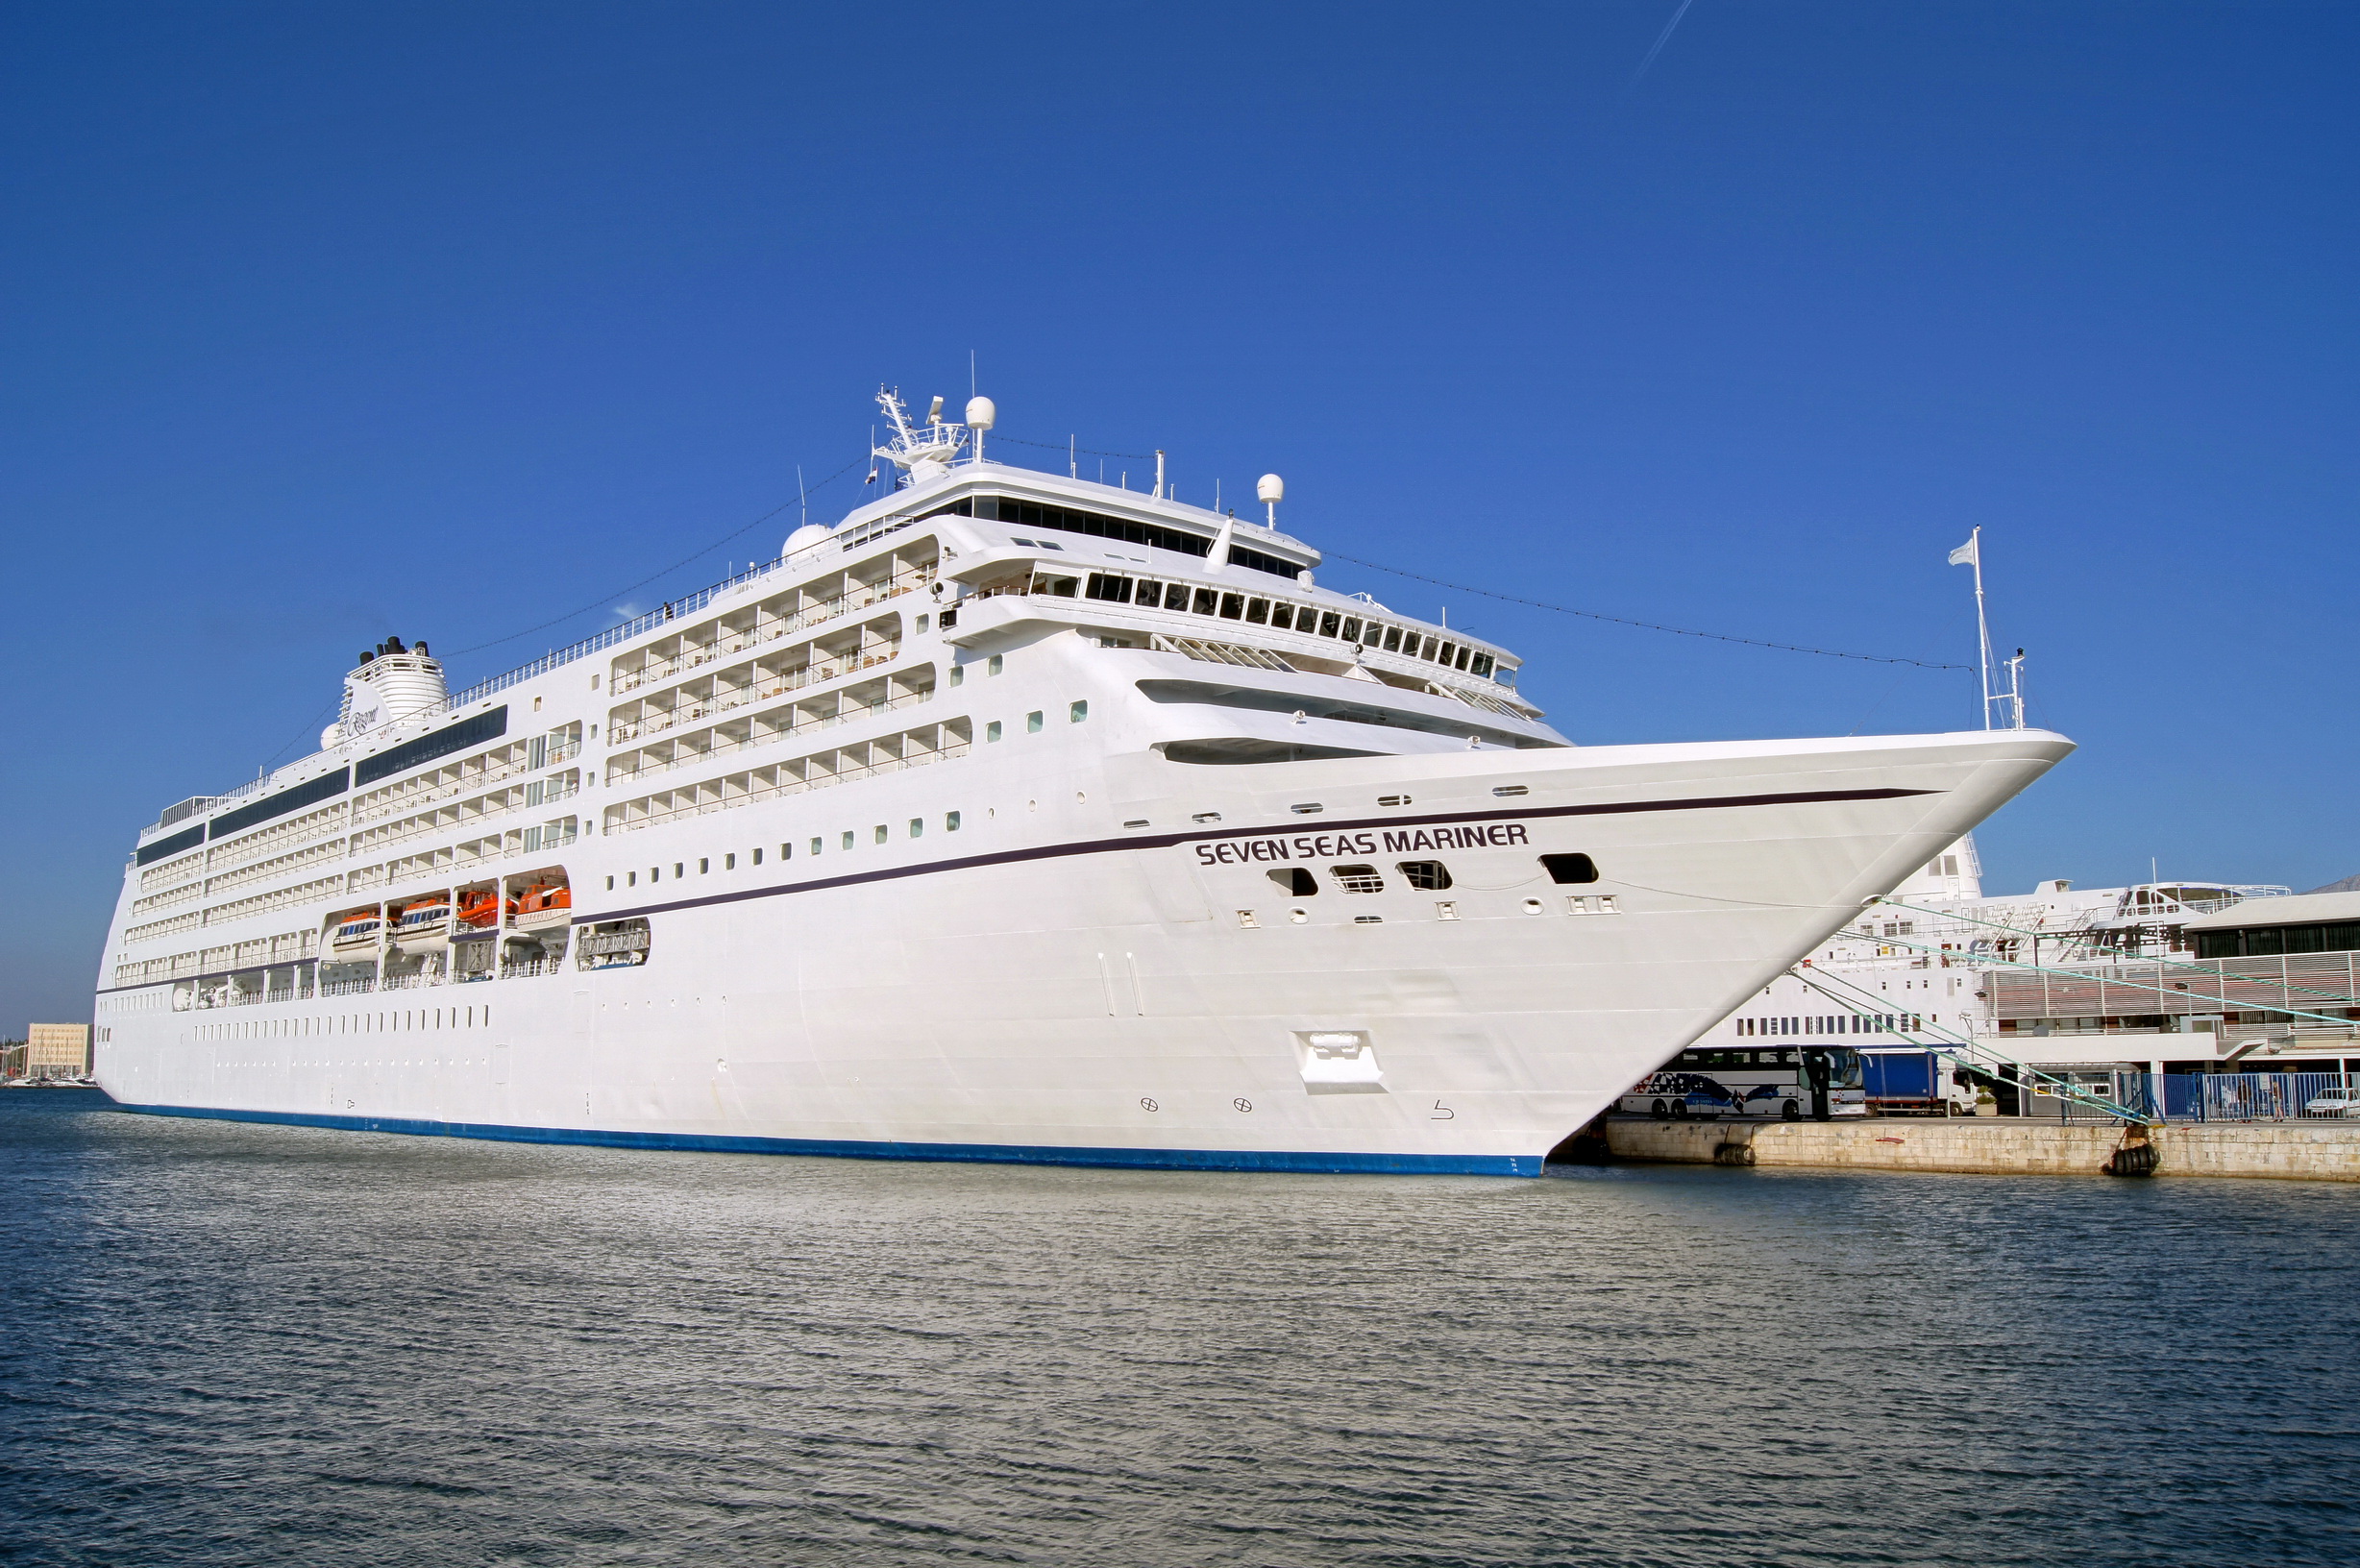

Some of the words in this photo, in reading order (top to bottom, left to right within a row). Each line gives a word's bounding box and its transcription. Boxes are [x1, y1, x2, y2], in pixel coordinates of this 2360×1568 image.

[1195, 839, 1291, 866] SEVEN
[1293, 833, 1377, 859] SEAS
[1382, 823, 1530, 853] MARINER
